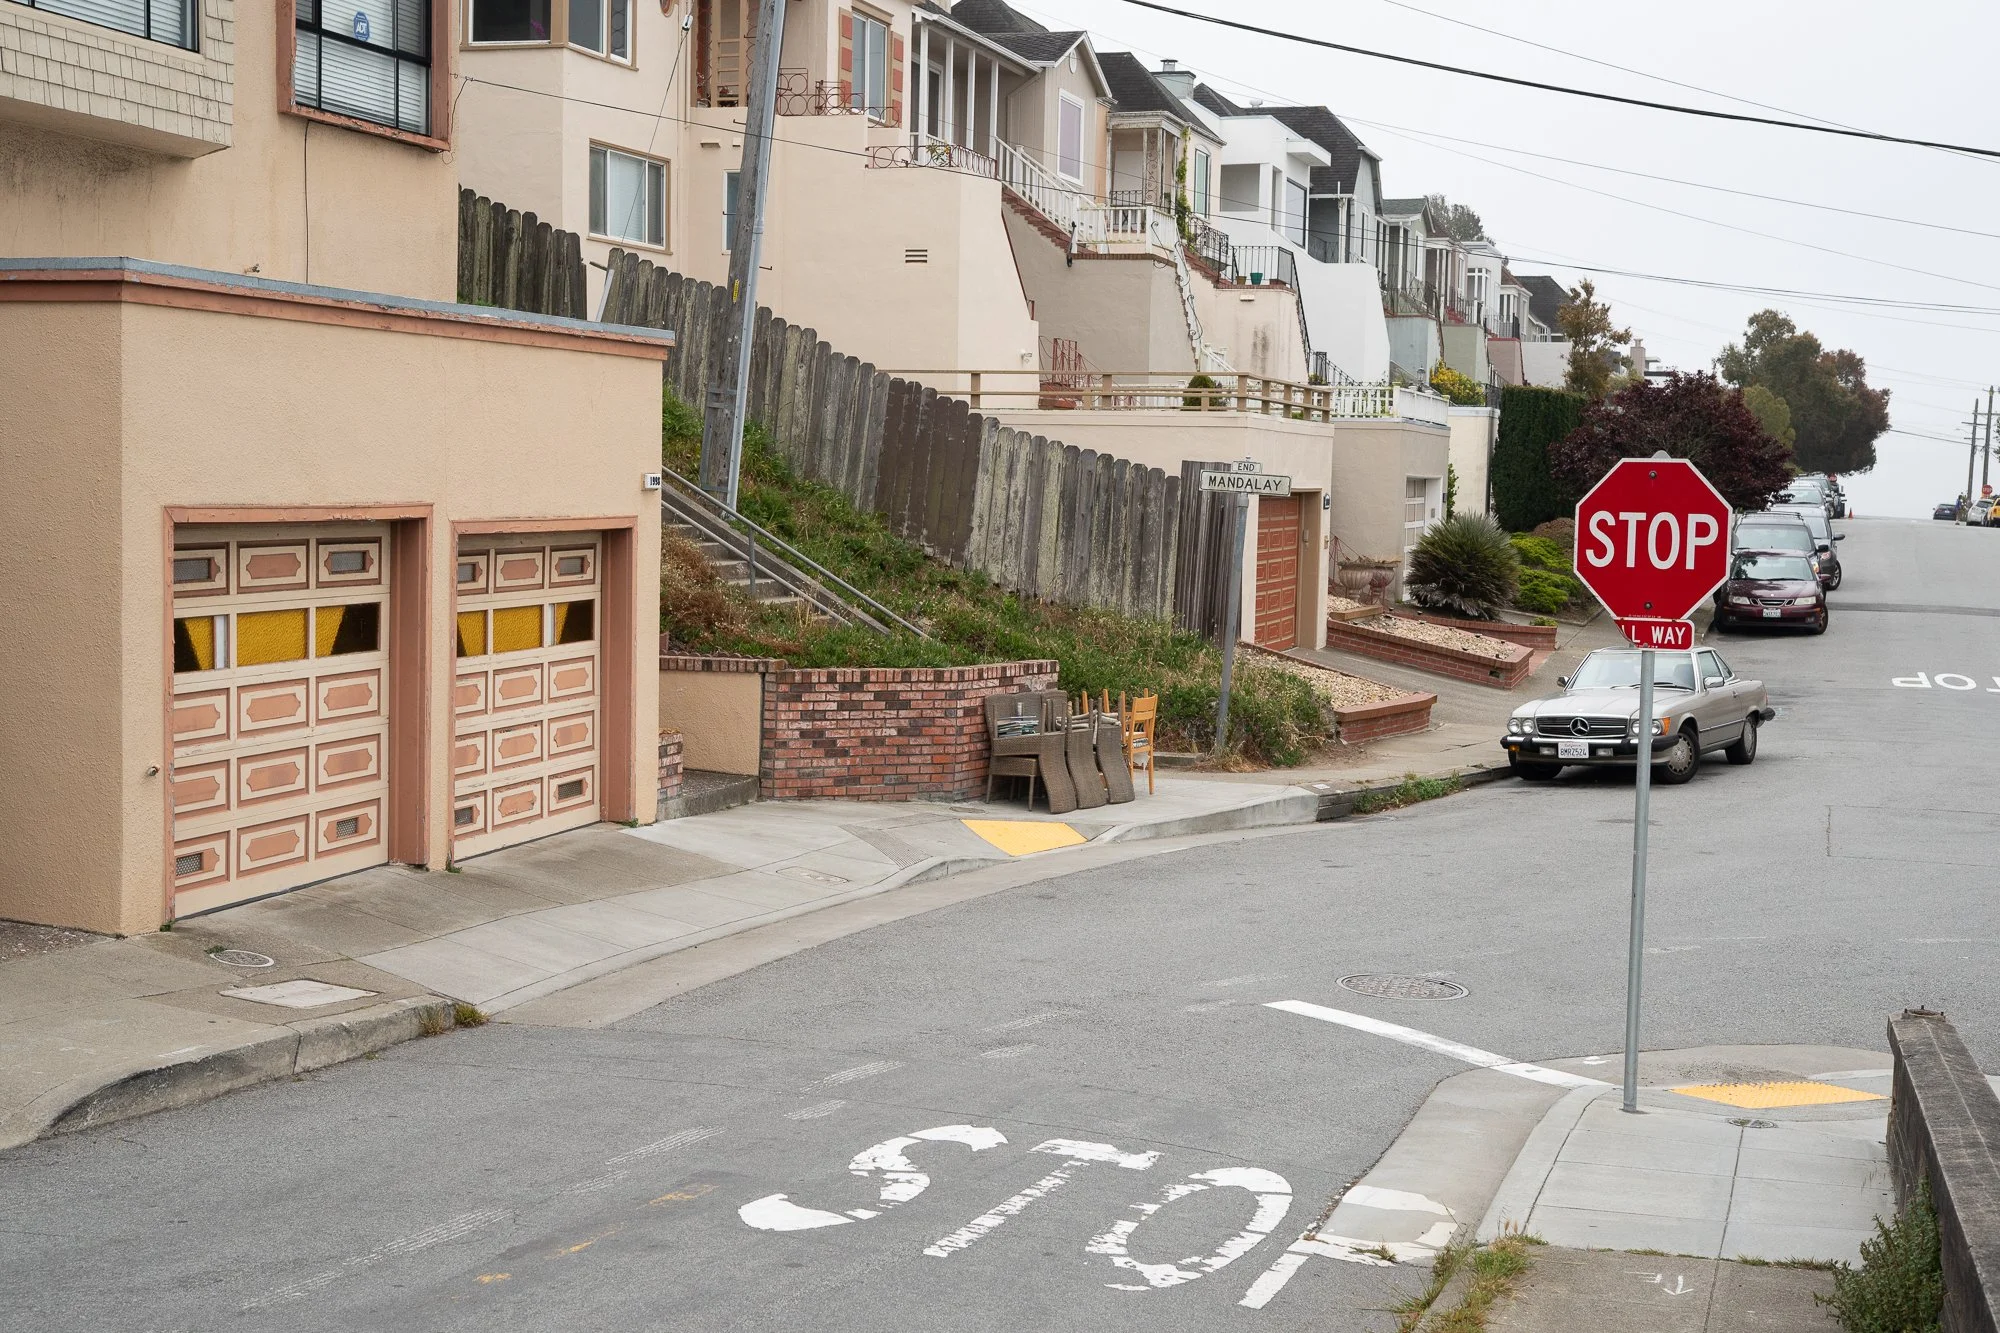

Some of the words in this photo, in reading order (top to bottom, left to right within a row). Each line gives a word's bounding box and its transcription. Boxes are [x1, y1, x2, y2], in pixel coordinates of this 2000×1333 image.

[355, 21, 367, 34] ADT
[1237, 463, 1255, 472] END
[1208, 475, 1282, 491] MANDALAY
[1585, 510, 1719, 570] STOP
[1651, 626, 1686, 645] WAY
[738, 1124, 1458, 1310] STOP
